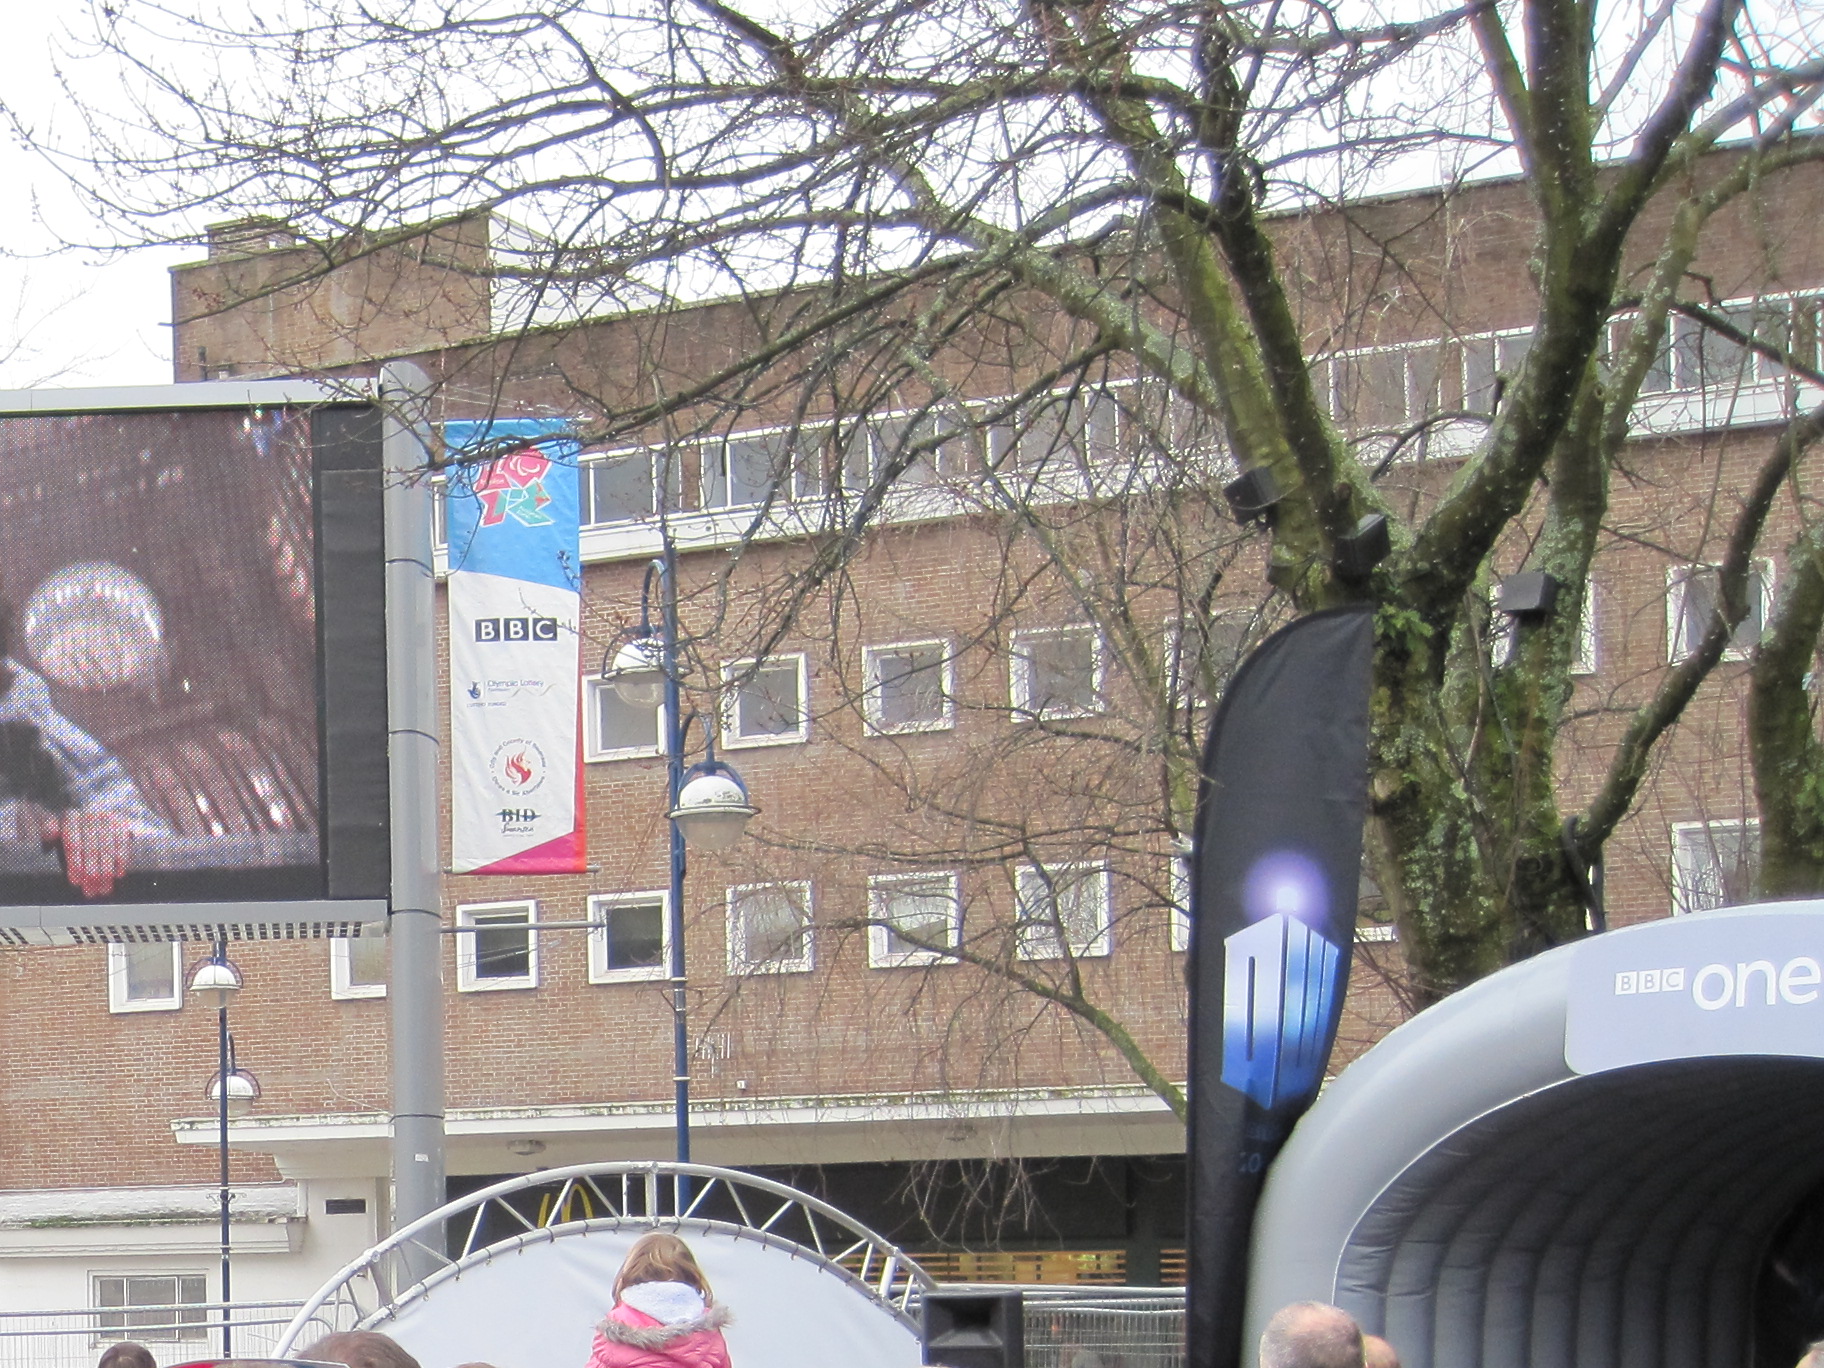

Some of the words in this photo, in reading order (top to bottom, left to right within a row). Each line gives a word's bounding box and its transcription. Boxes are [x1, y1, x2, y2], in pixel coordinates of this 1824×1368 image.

[478, 619, 555, 640] BBC
[487, 679, 518, 688] Olympic
[520, 679, 544, 688] Lottery
[501, 808, 536, 822] BID
[1618, 970, 1682, 993] BBC
[1691, 956, 1822, 1011] one
